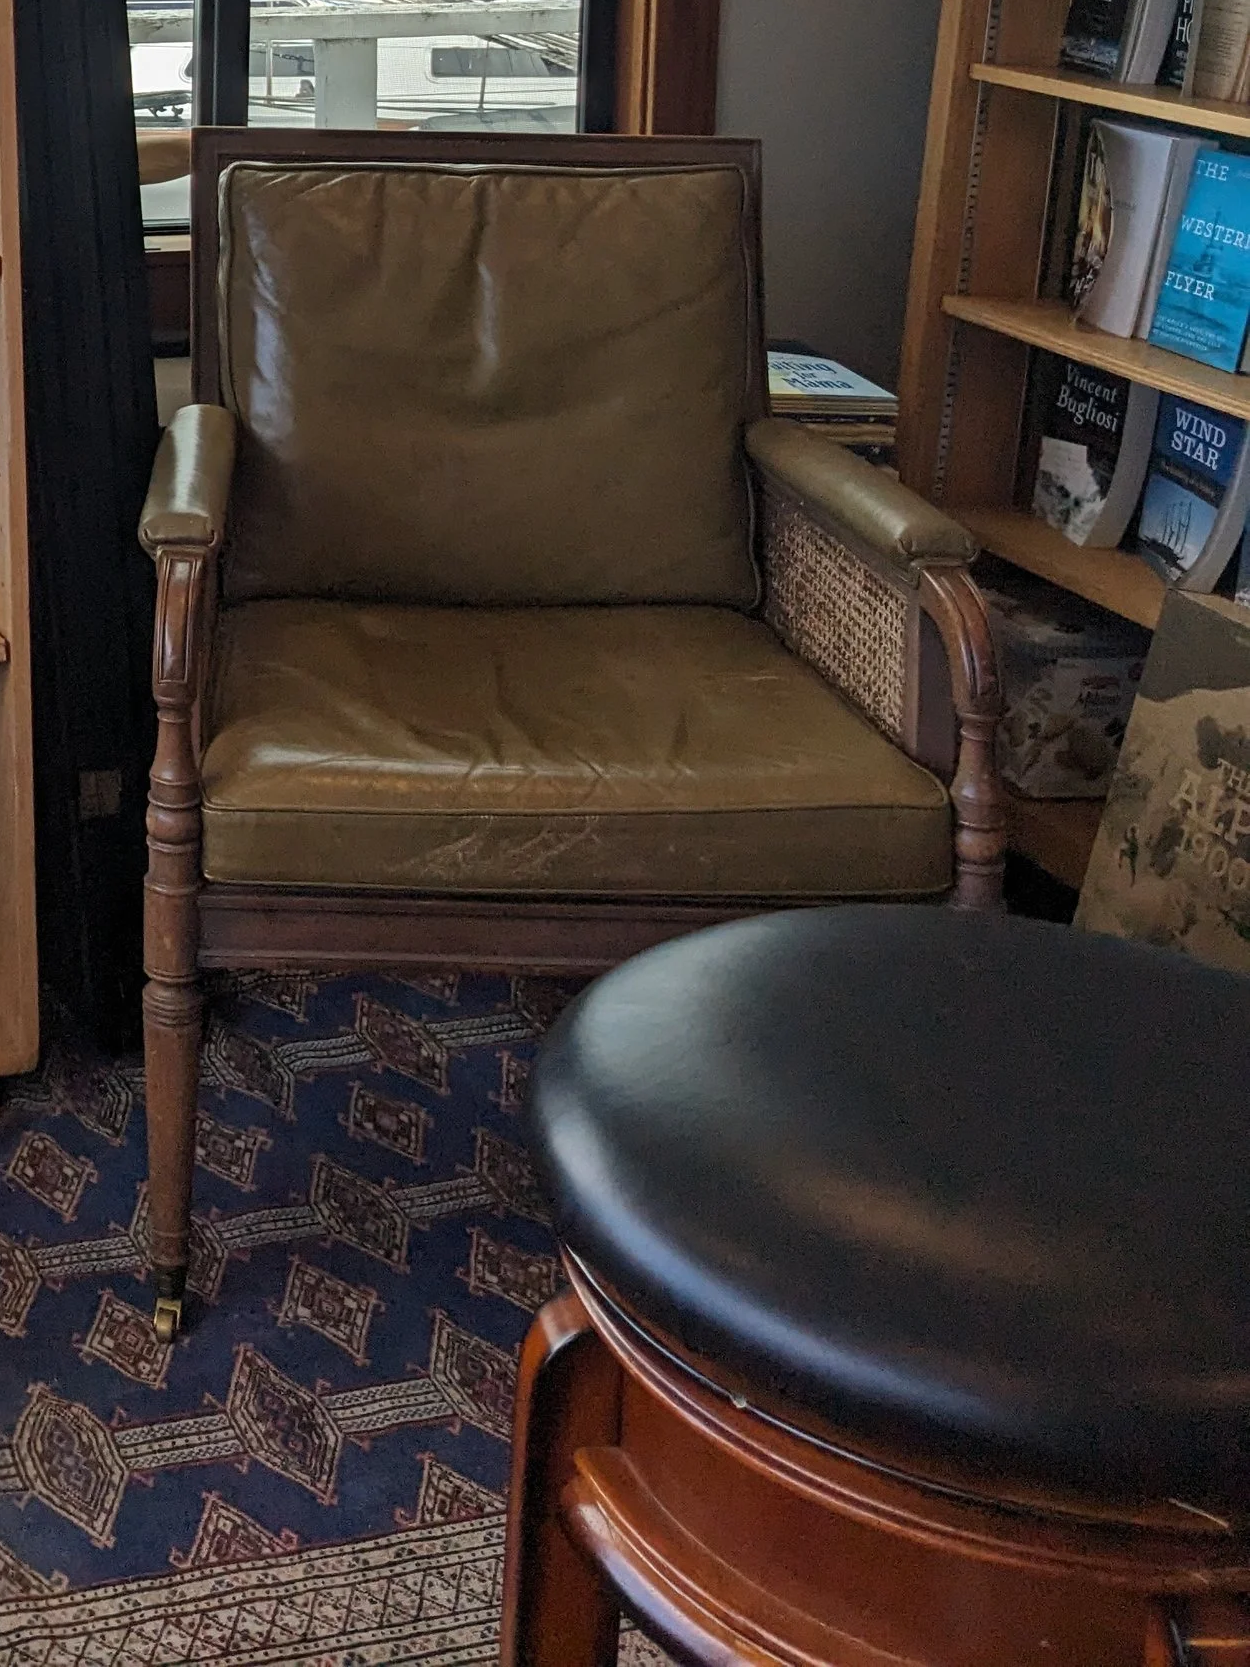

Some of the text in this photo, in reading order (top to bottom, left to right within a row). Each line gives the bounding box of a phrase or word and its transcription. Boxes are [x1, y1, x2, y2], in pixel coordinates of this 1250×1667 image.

[1197, 159, 1230, 181] THE
[1181, 214, 1250, 250] WESTER
[1165, 270, 1215, 301] FLYER
[1066, 364, 1118, 403] Vincent
[1056, 385, 1121, 432] Bugliosi
[1175, 407, 1226, 448] WIND
[1171, 431, 1221, 470] STAR
